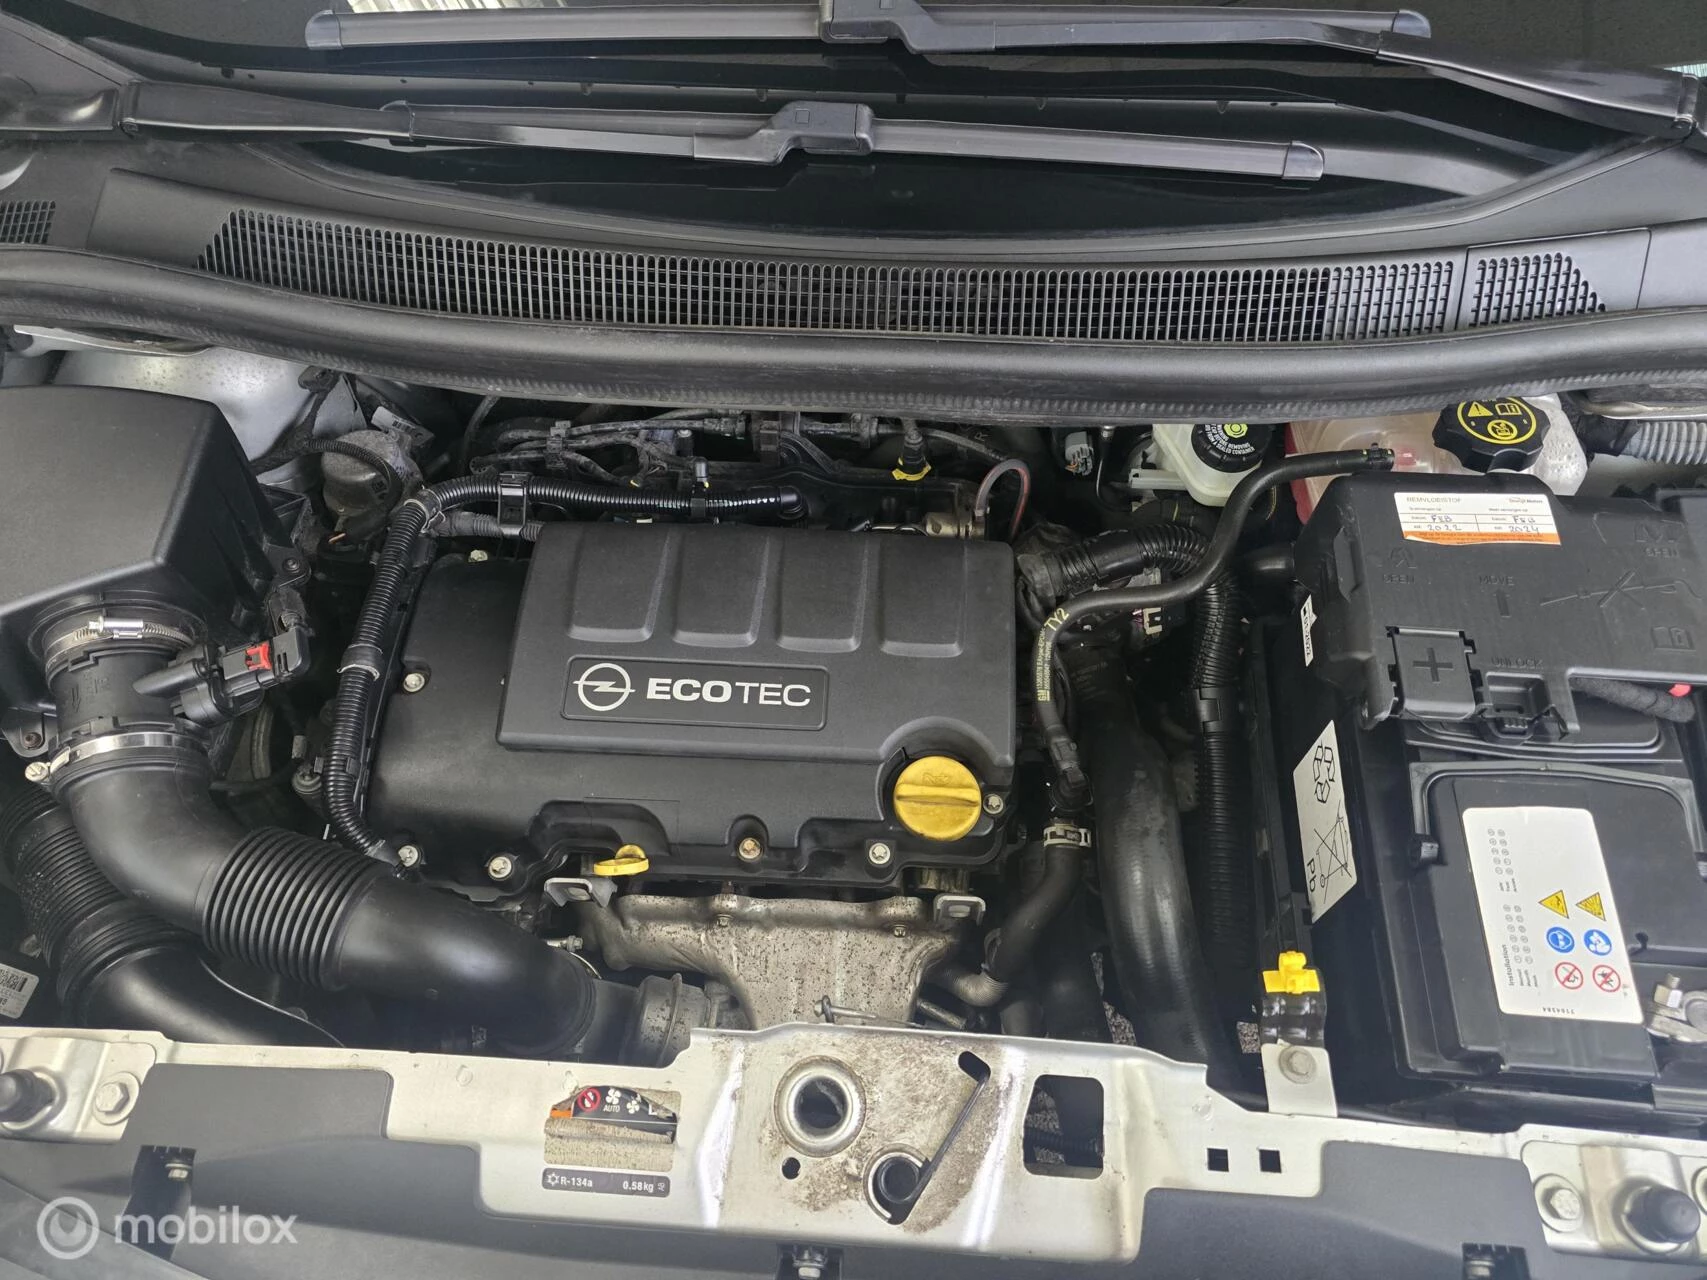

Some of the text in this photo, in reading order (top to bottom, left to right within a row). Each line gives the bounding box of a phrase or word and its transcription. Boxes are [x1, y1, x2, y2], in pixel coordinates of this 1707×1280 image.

[1427, 524, 1462, 532] 2022
[1509, 526, 1539, 534] 2024
[1479, 576, 1514, 586] MOVE
[1044, 608, 1070, 631] TY2
[646, 677, 811, 707] ECOTEC
[1307, 858, 1317, 892] Pb
[603, 1105, 620, 1113] AUTO
[560, 1176, 593, 1187] R-134a
